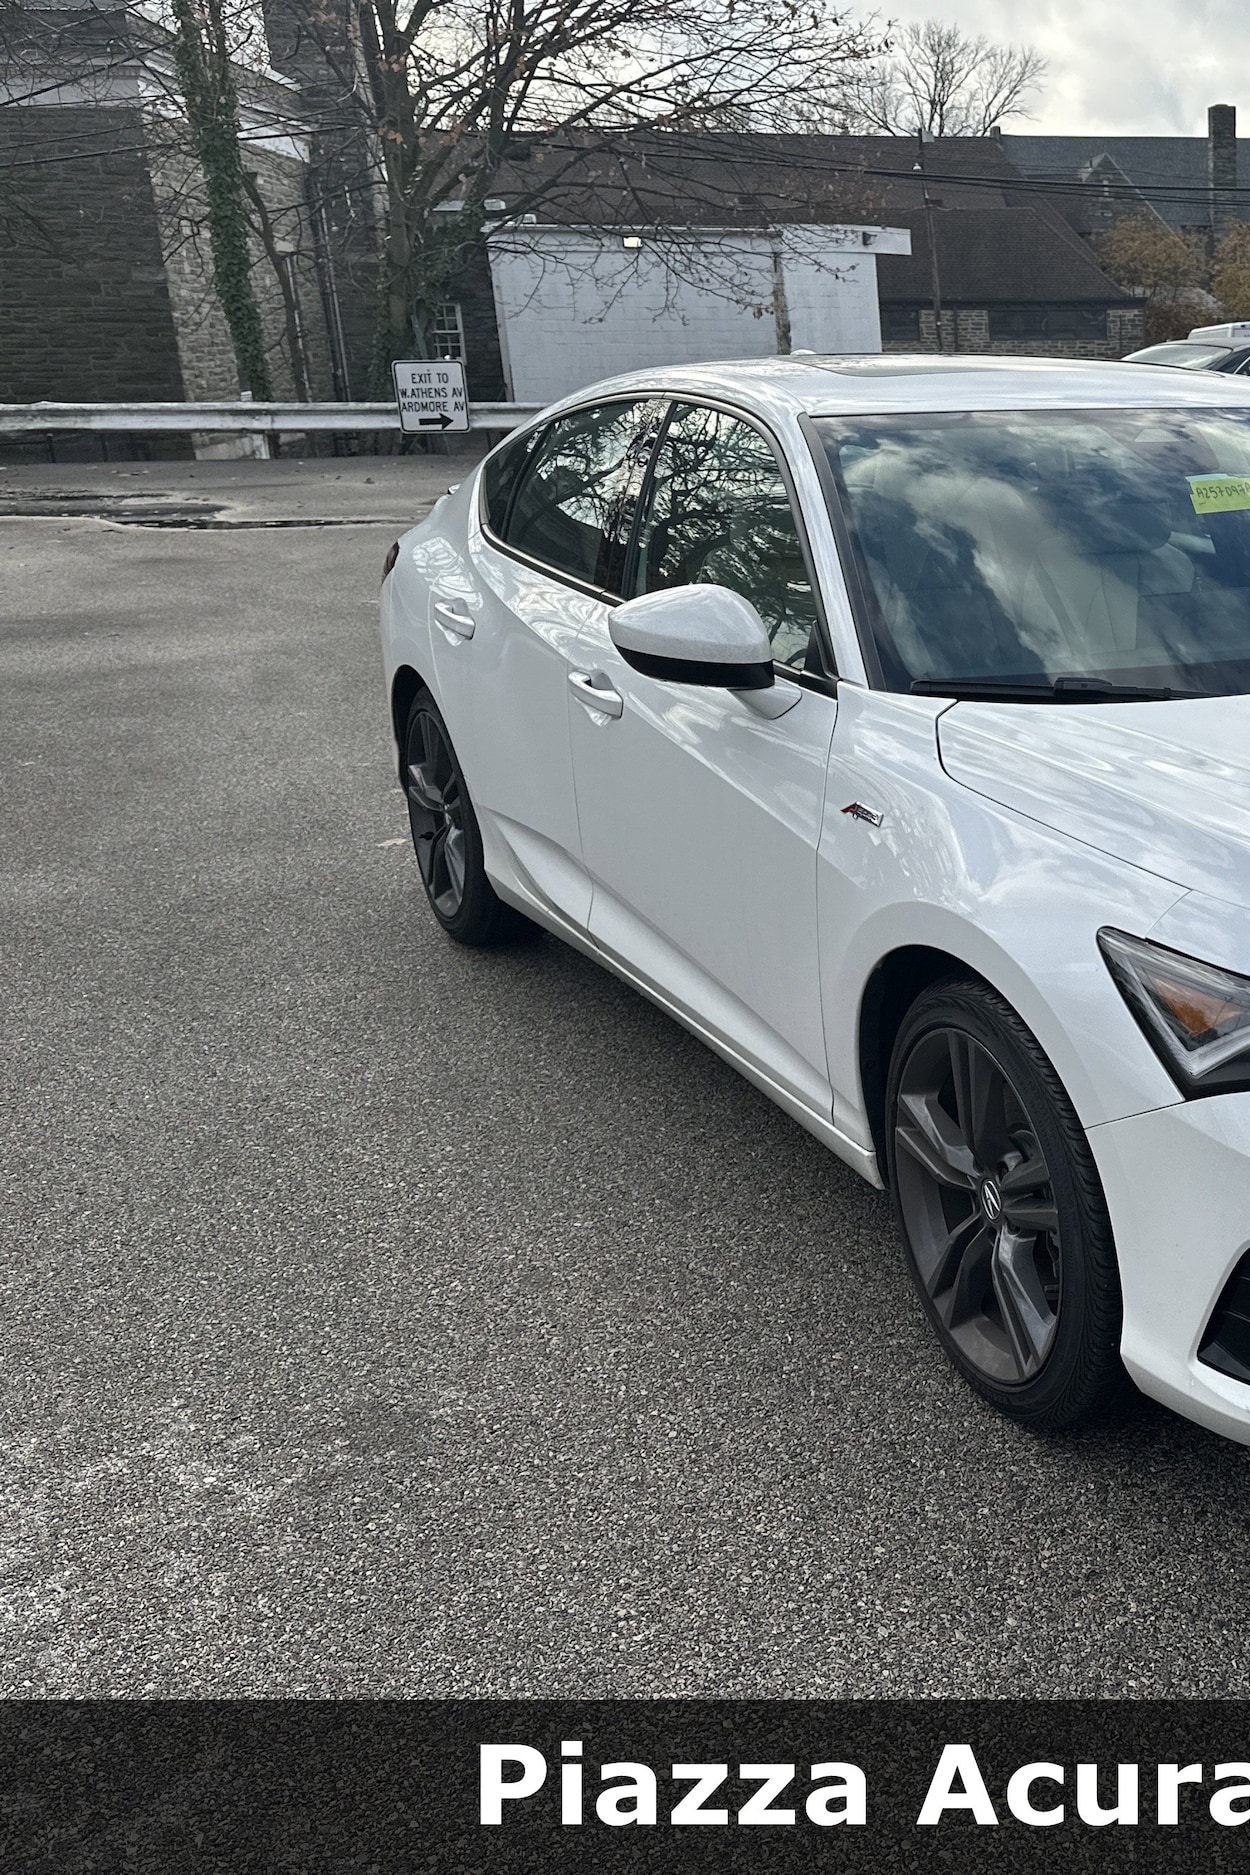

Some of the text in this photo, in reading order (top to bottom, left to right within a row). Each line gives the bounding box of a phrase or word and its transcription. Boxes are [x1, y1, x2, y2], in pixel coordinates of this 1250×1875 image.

[411, 373, 449, 384] EXIT TO
[451, 387, 463, 398] AV
[401, 401, 465, 412] ARDMORE AV
